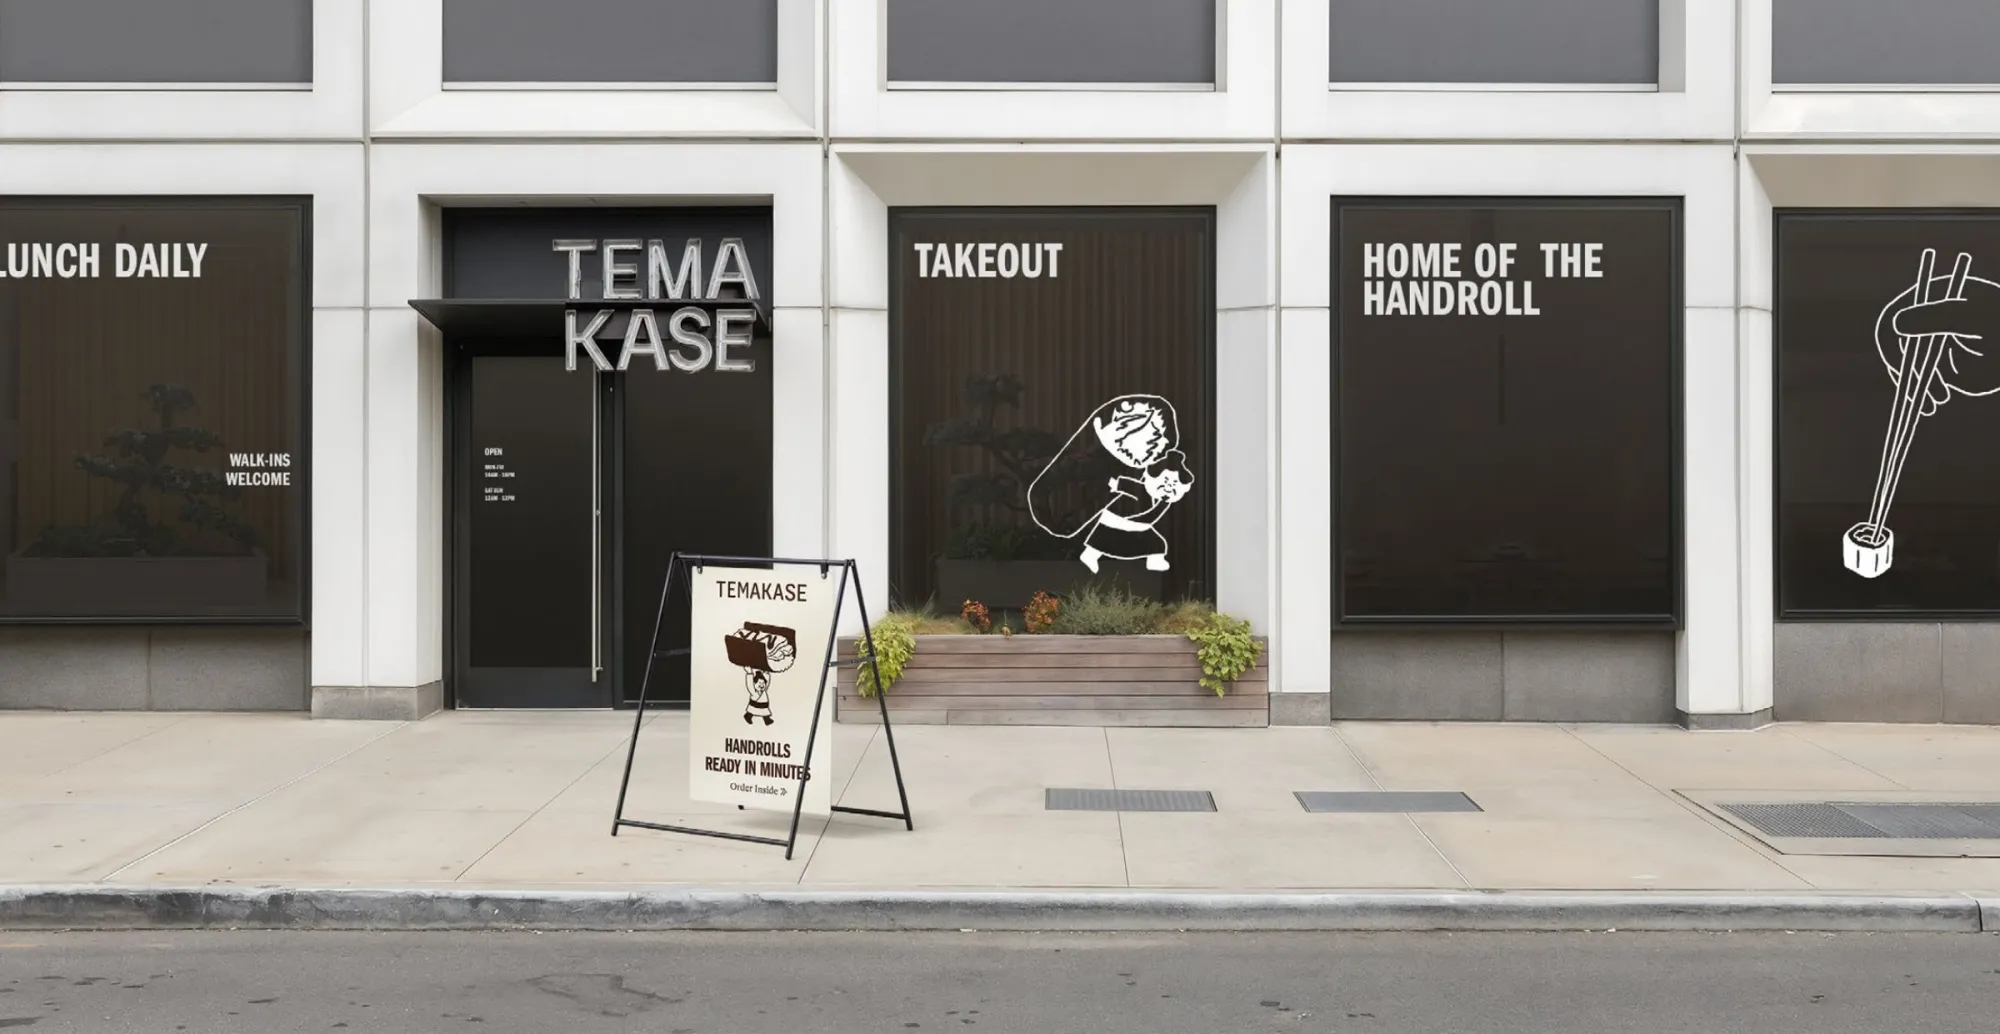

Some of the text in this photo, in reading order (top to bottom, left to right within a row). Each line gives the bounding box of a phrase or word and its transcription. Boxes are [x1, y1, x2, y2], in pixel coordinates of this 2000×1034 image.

[0, 242, 208, 279] UNCH DAILY
[552, 238, 761, 300] TEMA
[914, 242, 1063, 279] TAKEOUT
[1363, 242, 1604, 278] HOME OF THE
[1363, 280, 1541, 316] HANDROLL
[564, 306, 757, 373] KASE
[229, 452, 291, 467] WALK-INS
[484, 447, 504, 456] OPEN
[225, 472, 291, 486] WELCOME
[716, 580, 807, 602] TEMAKASE
[725, 738, 791, 758] HANDROLLS
[705, 756, 741, 774] READY
[744, 760, 757, 776] IN
[729, 782, 779, 796] Order Inside
